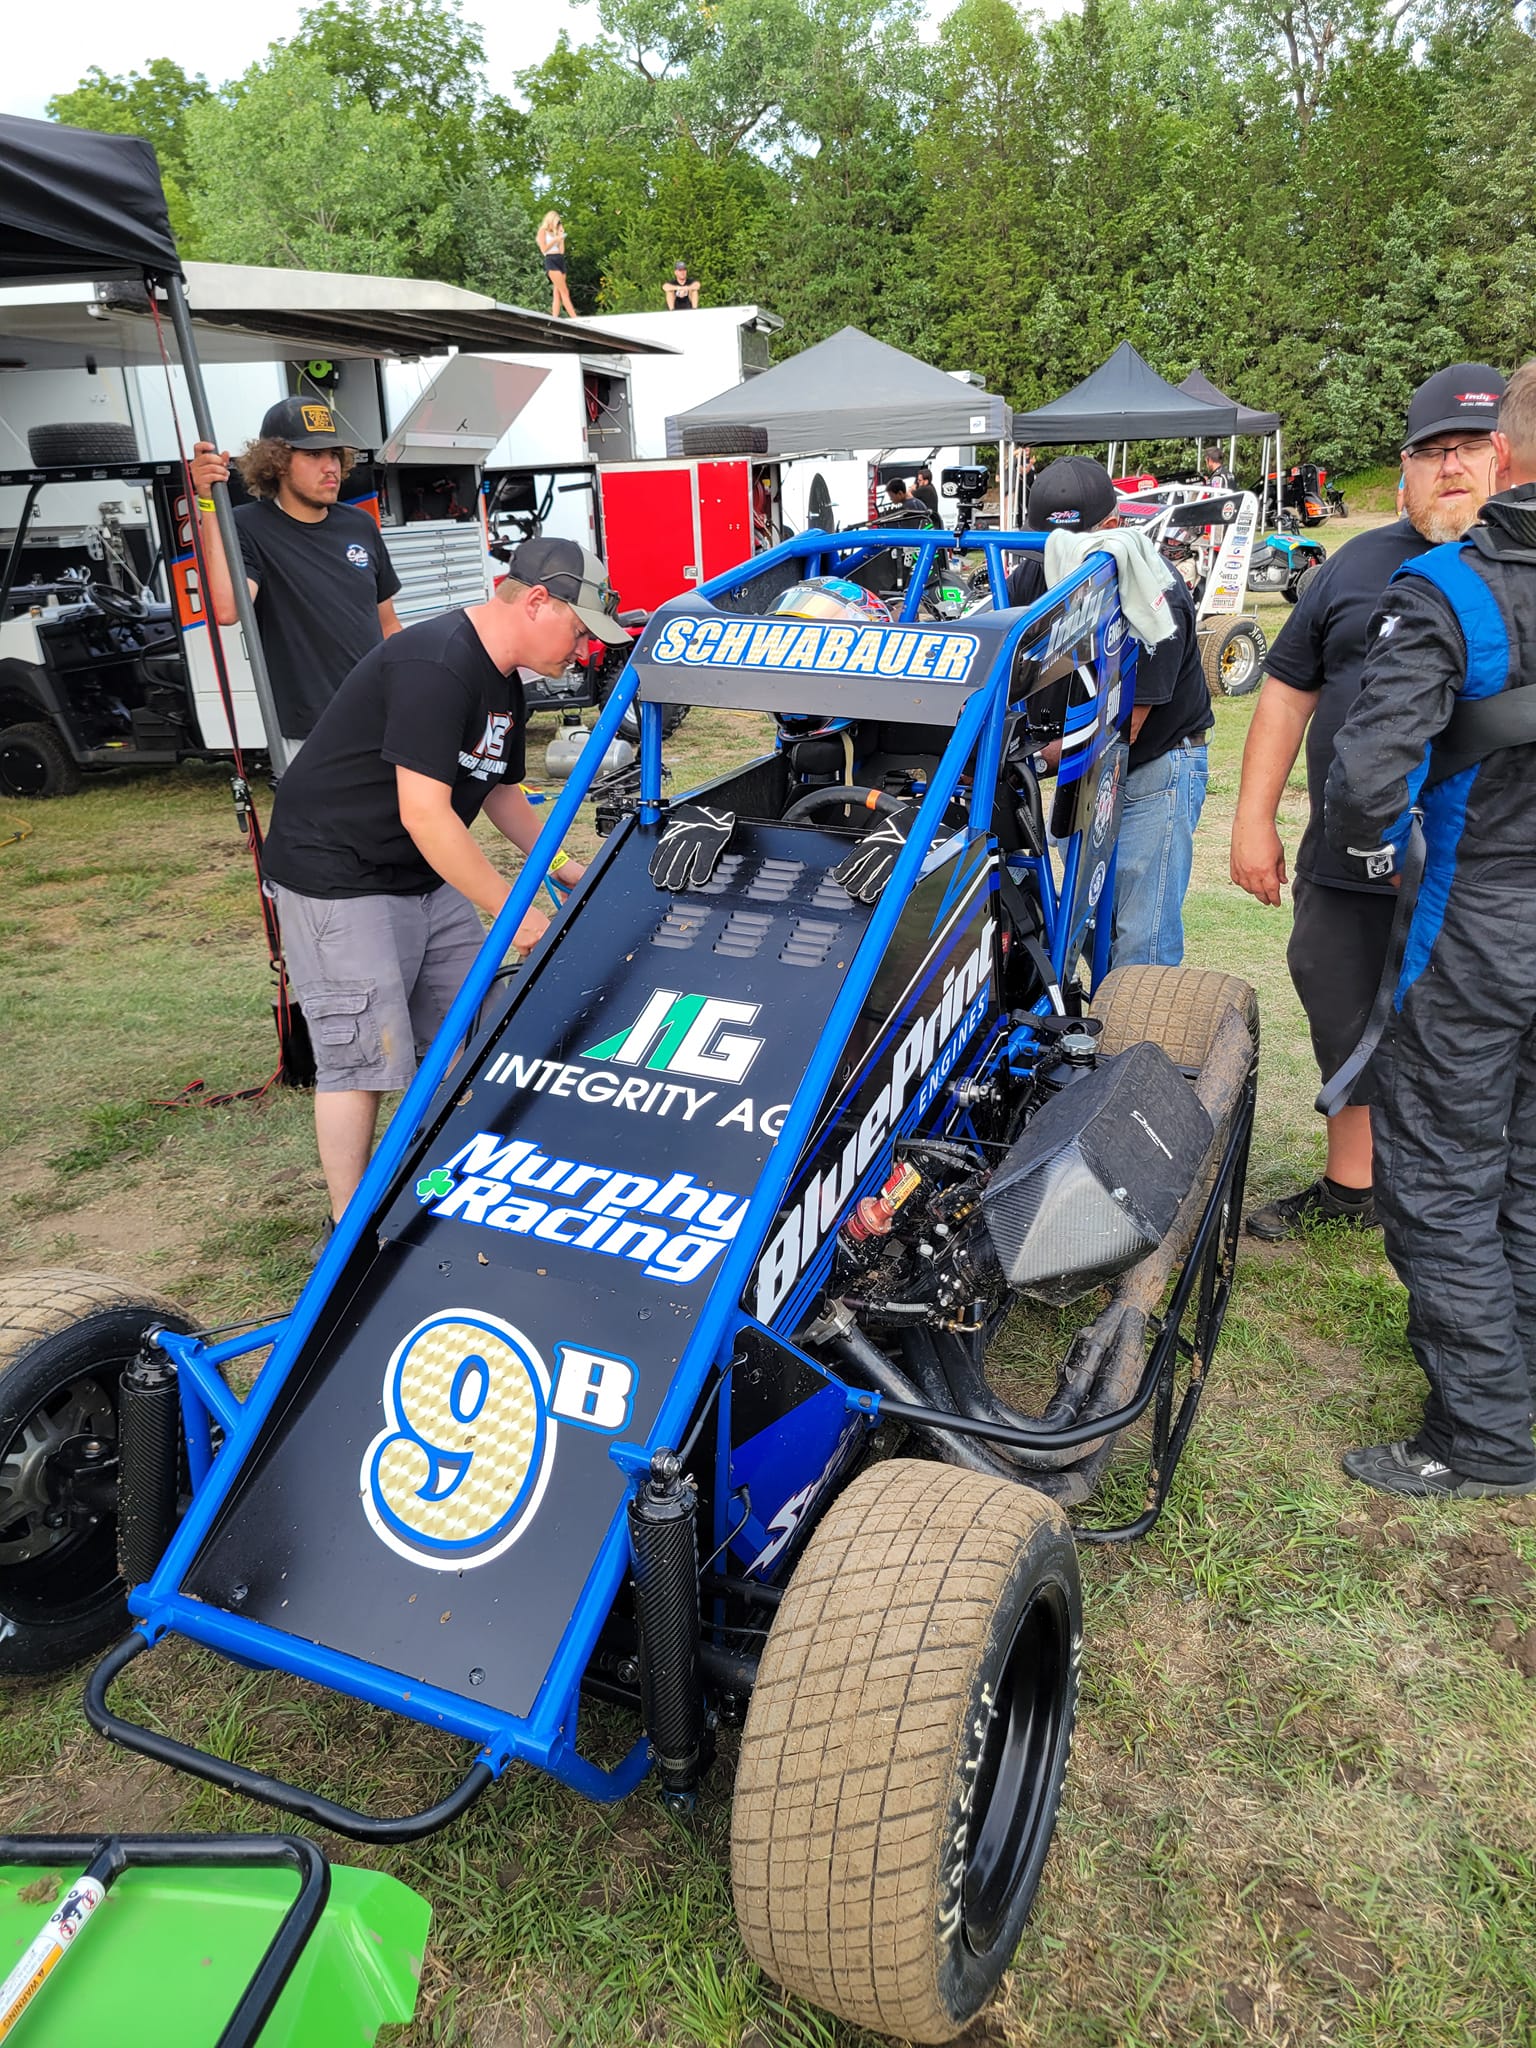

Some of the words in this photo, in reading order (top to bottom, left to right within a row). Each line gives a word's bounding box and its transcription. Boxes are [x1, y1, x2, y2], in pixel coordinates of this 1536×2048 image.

[651, 616, 981, 683] SCHWABAUER
[484, 1052, 717, 1121] INTEGRITY
[917, 996, 989, 1117] ENGINES
[428, 1175, 730, 1285] Racing
[443, 1131, 751, 1241] Murphy
[3, 1979, 40, 2029] WARNING
